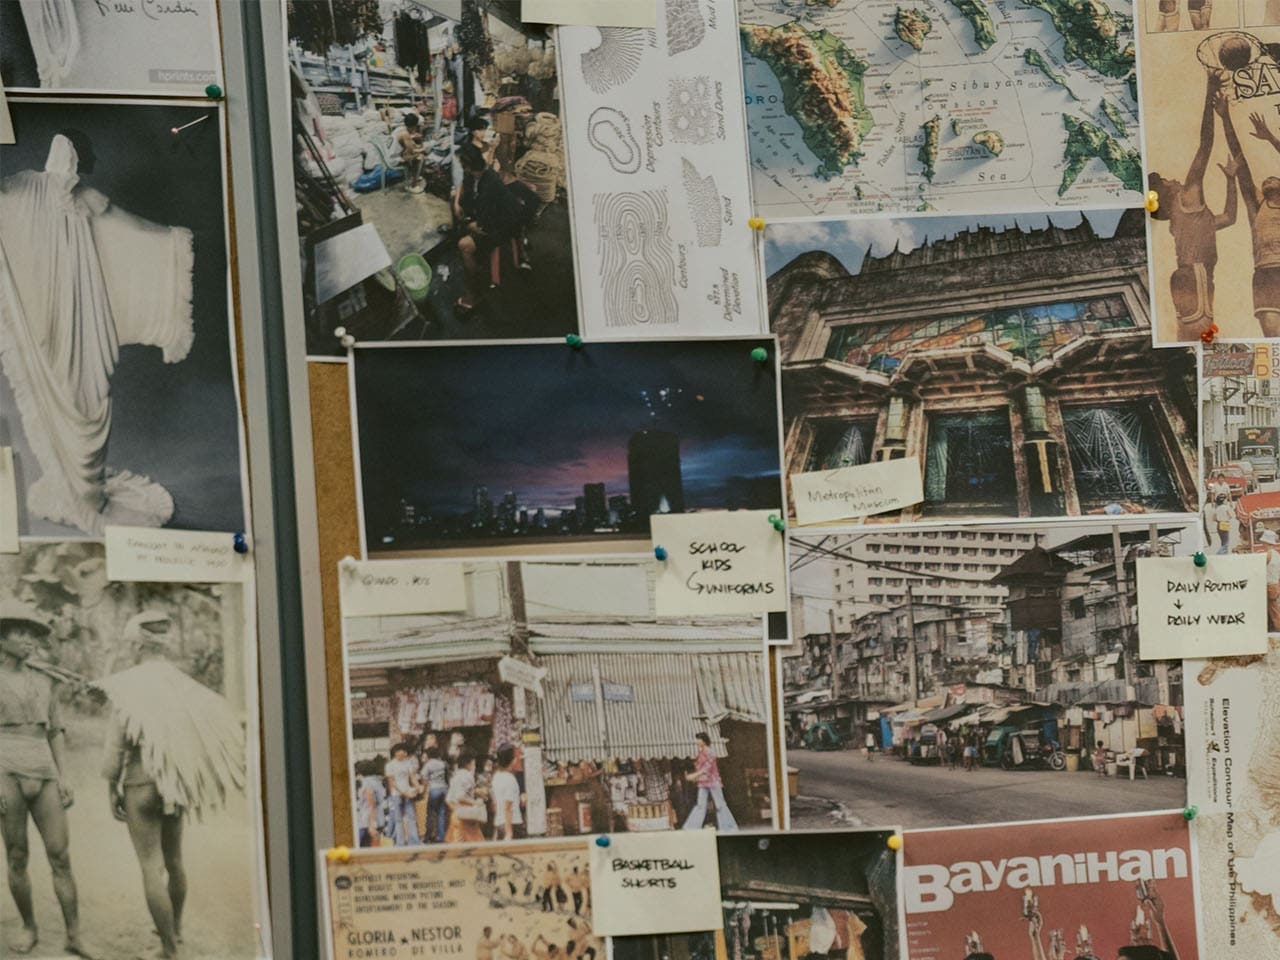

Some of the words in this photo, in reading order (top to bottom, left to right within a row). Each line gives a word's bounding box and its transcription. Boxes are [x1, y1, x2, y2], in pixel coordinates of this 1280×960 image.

[976, 171, 1008, 182] Sea
[688, 541, 746, 555] SCHOOL
[701, 558, 733, 572] KIDS
[705, 581, 776, 595] UNIFORMS
[1167, 580, 1201, 593] DAILY
[1203, 579, 1249, 592] ROUTINE
[1167, 614, 1201, 626] DAILY
[1206, 611, 1246, 626] WEAR
[1221, 697, 1230, 754] Elevation
[1224, 757, 1233, 809] Contour
[1226, 812, 1235, 838] Map
[611, 858, 695, 872] BASKETBALL
[621, 877, 678, 889] SHORTS
[347, 930, 396, 946] GLORIA
[411, 925, 462, 942] NESTOR
